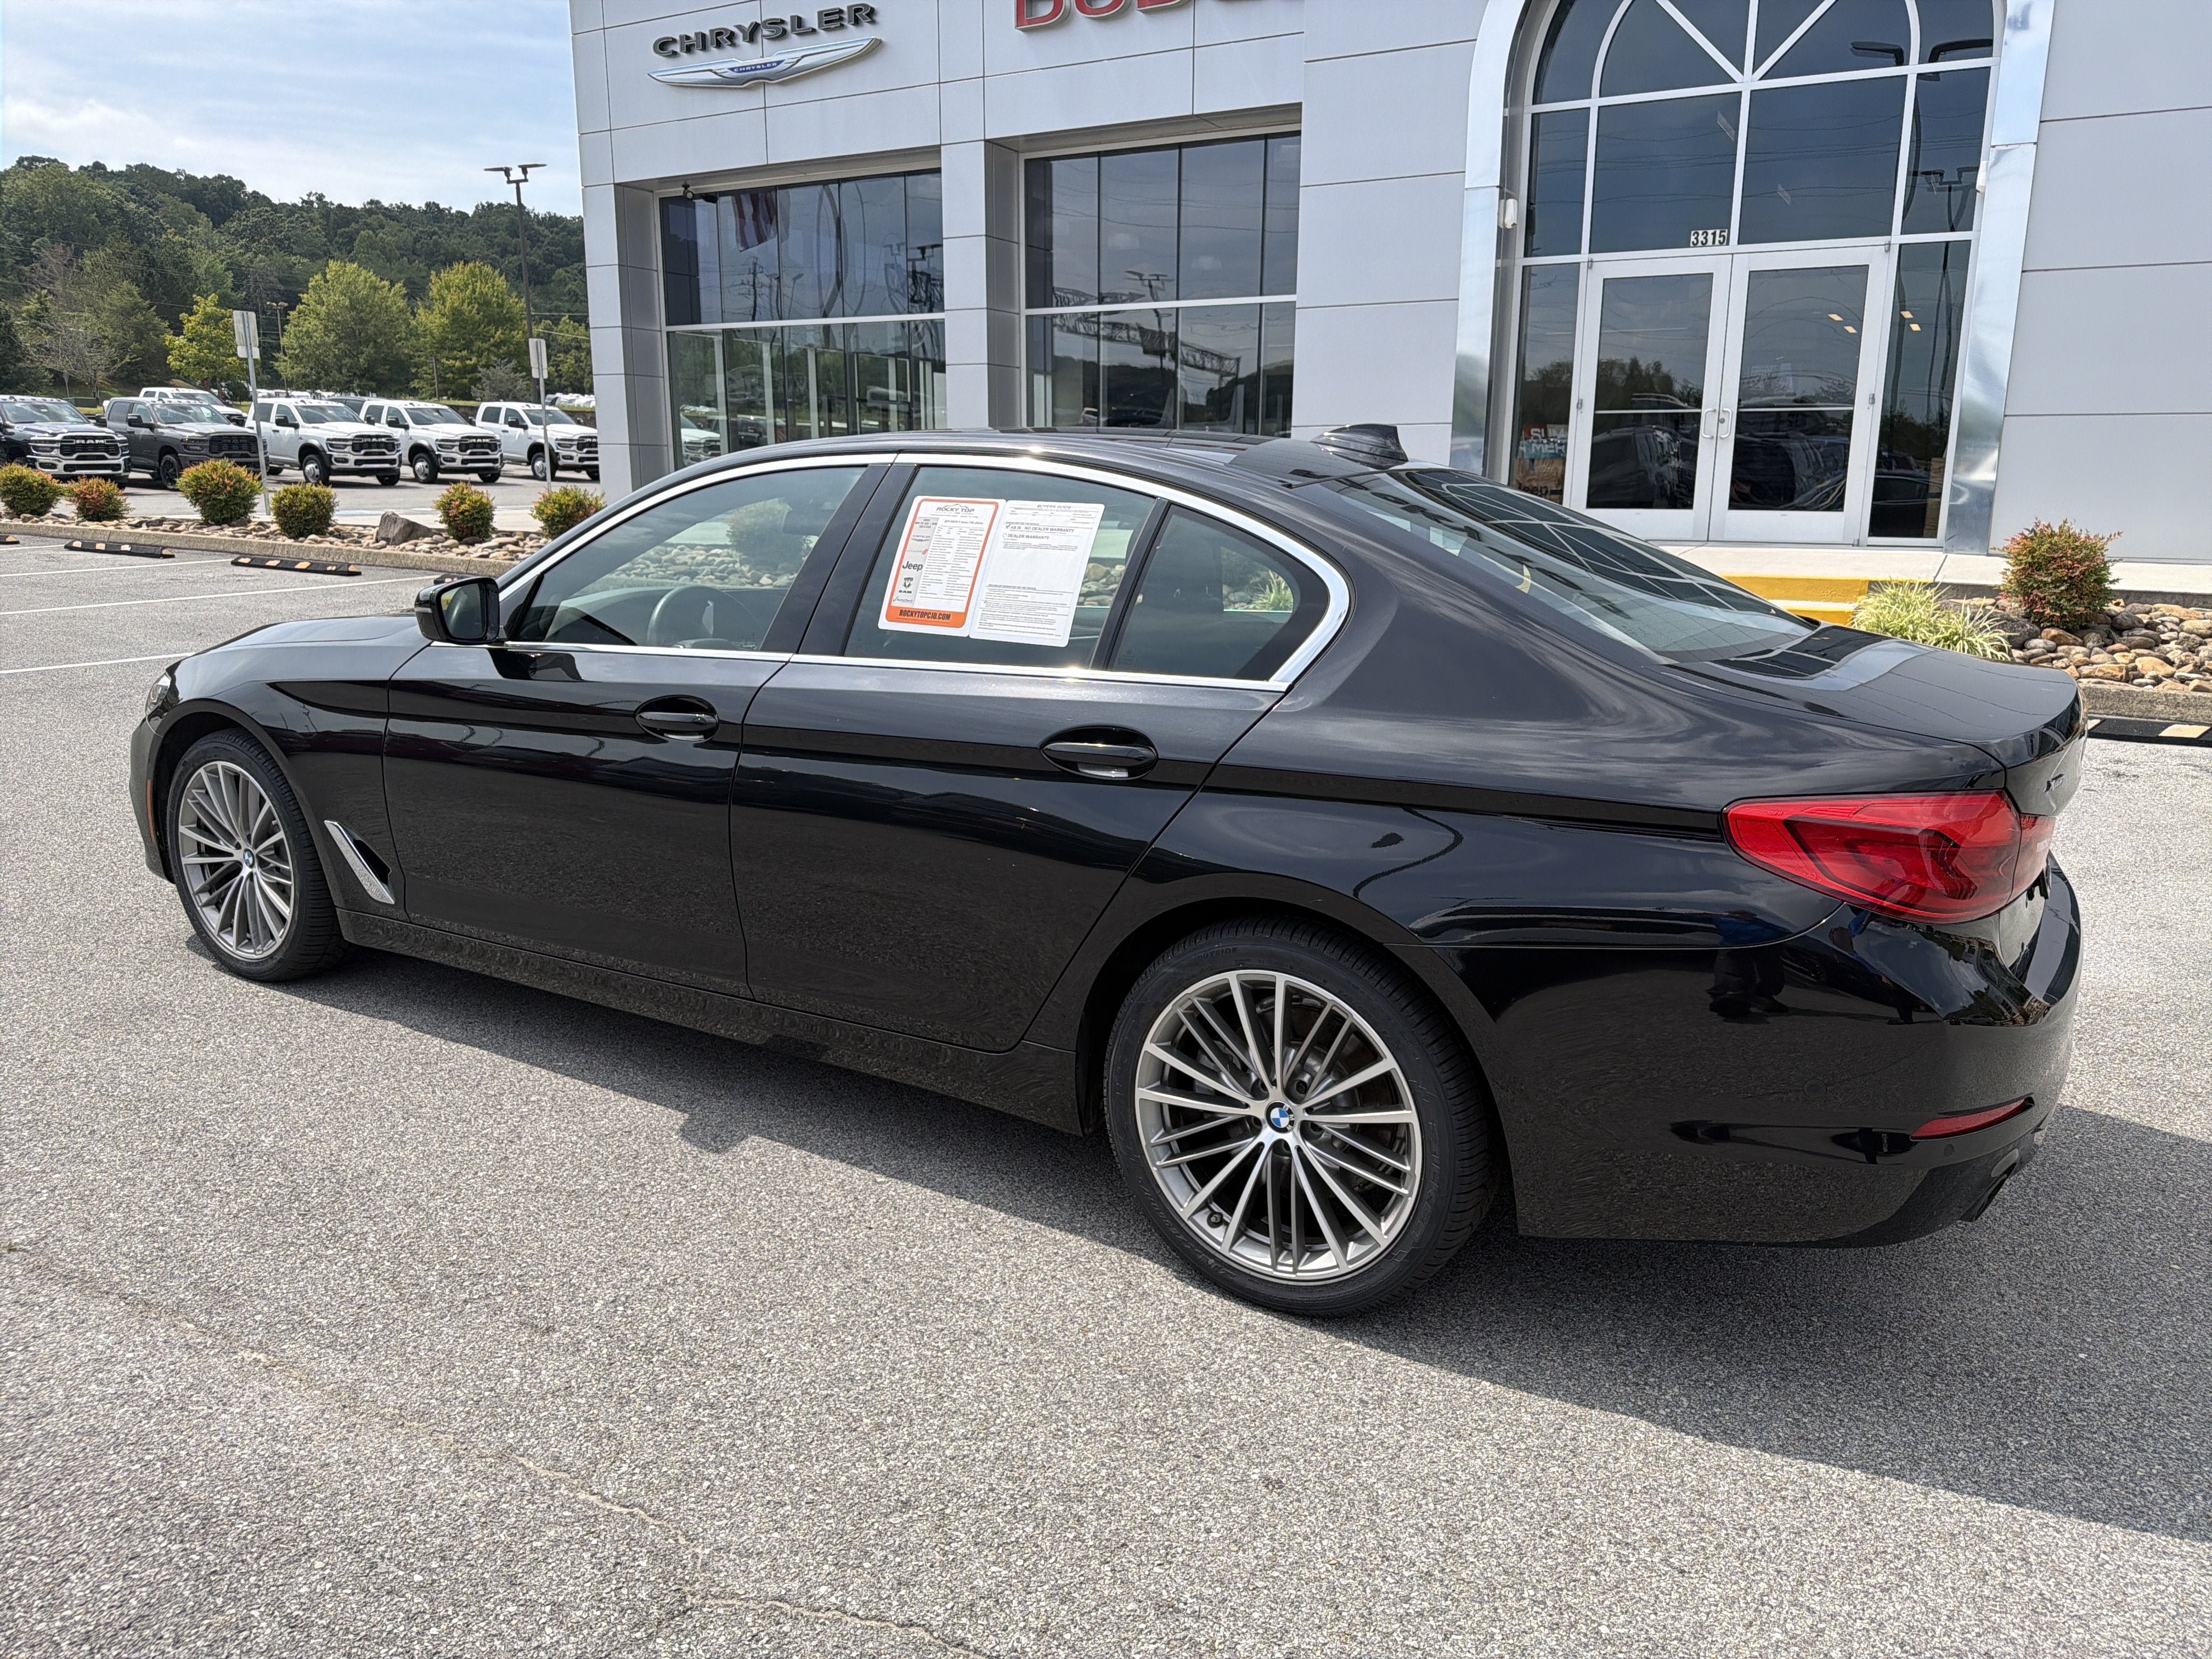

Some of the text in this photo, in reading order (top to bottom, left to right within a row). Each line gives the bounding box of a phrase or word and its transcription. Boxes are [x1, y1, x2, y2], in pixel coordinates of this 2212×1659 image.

[652, 3, 876, 57] CHRYSLER
[733, 62, 778, 72] CHRYSLER
[1691, 230, 1726, 246] 3315
[902, 560, 923, 572] Jeep
[899, 609, 951, 621] ROCKYTOPCJD.COM
[1282, 1104, 1295, 1132] BMW
